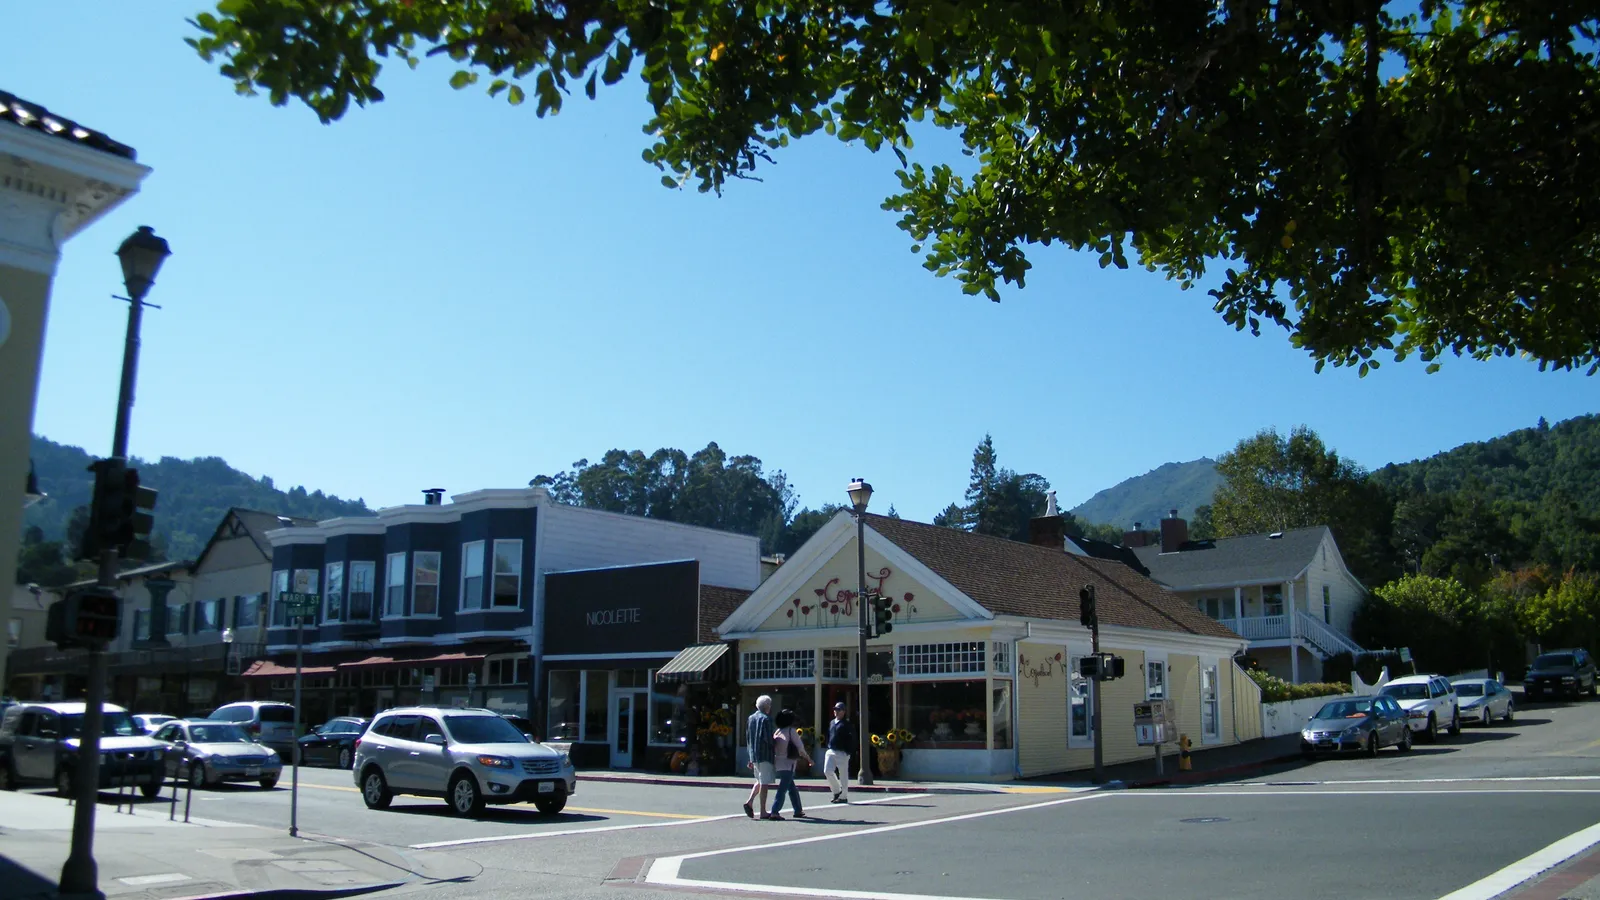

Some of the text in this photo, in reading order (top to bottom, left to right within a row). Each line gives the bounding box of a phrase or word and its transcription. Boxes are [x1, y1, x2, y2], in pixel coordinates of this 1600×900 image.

[282, 593, 321, 605] WARD ST
[586, 607, 641, 626] NICOLETTE
